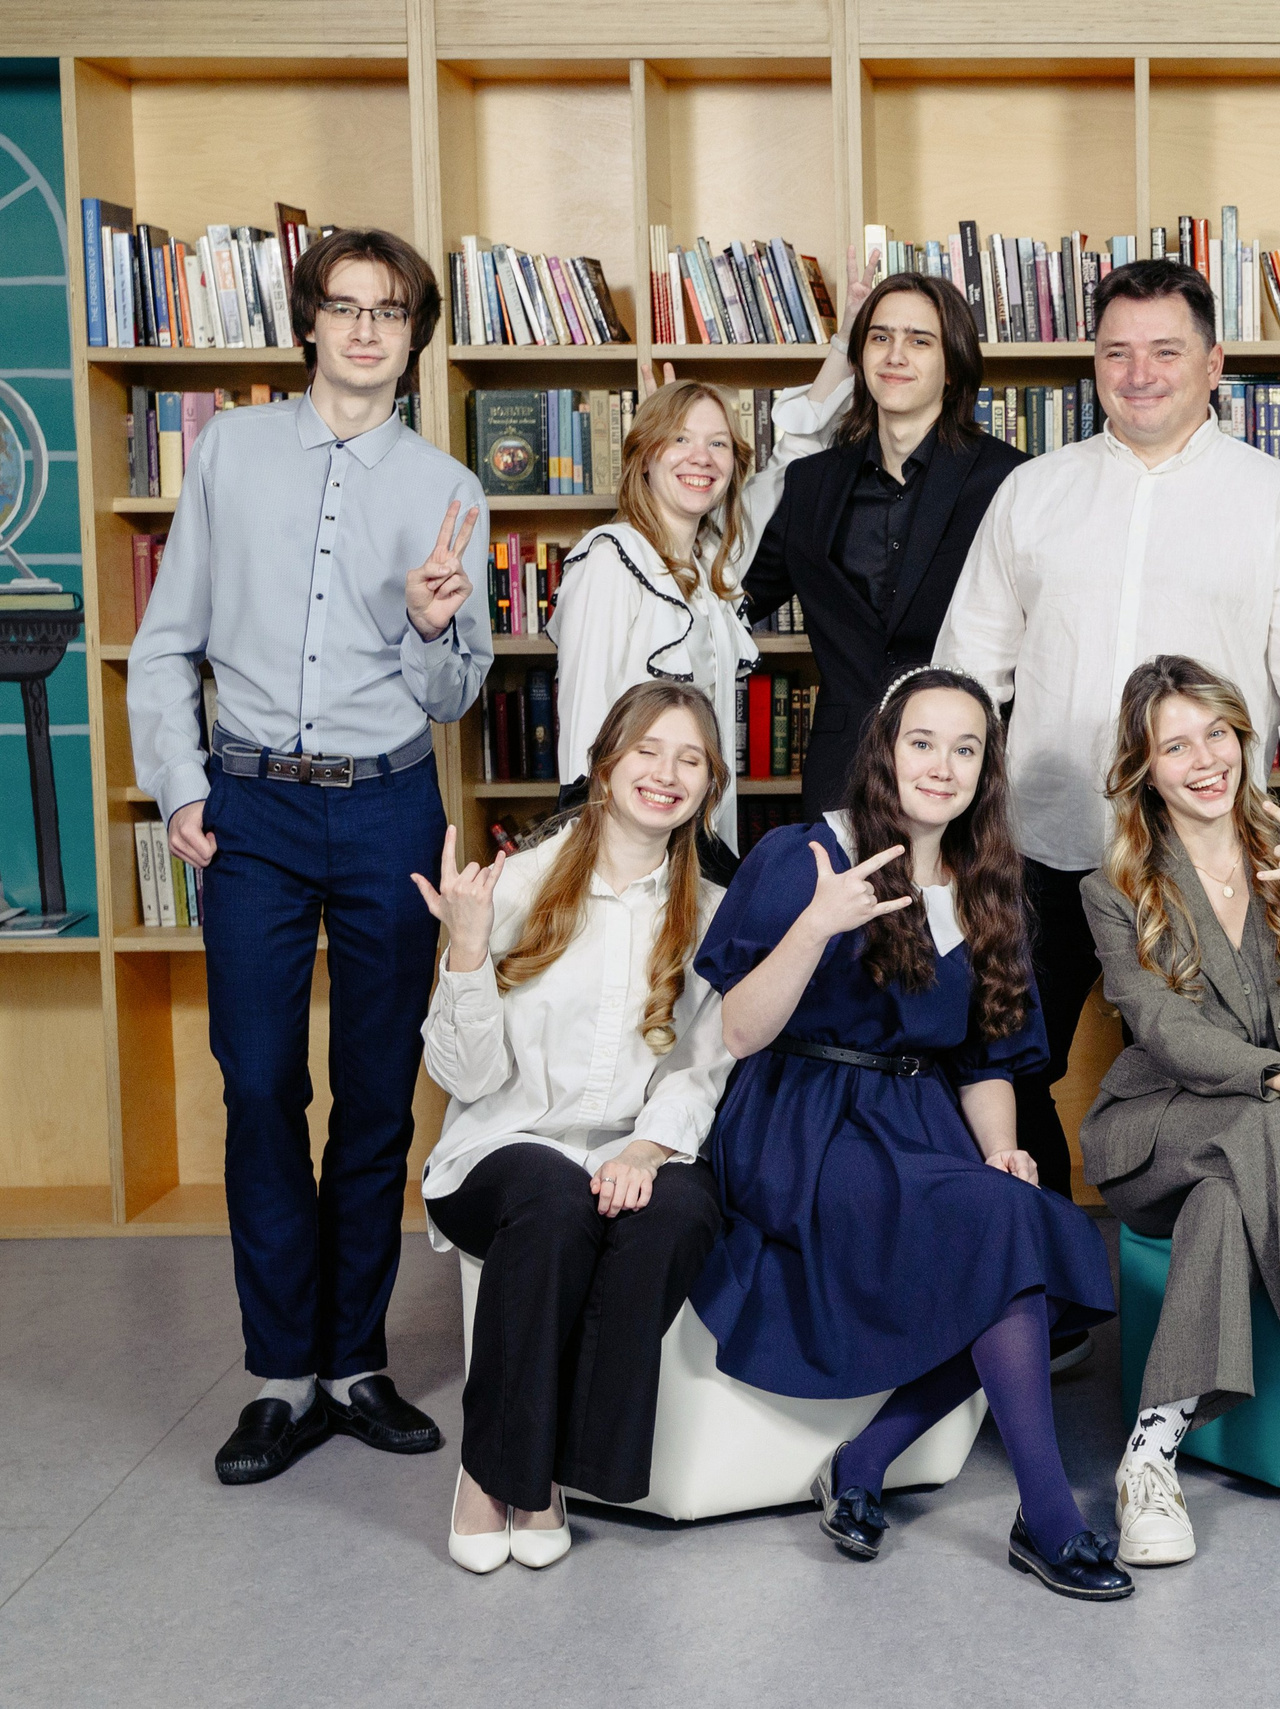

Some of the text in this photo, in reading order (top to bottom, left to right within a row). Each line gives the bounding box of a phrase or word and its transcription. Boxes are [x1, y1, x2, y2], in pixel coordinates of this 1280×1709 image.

[86, 209, 99, 323] THE FOREFRONT OF PHYSICS
[996, 286, 1005, 321] CARRIE
[1086, 307, 1094, 331] CIRCUS
[490, 406, 534, 416] ВОЛЬТЕР
[1081, 402, 1093, 438] SSES
